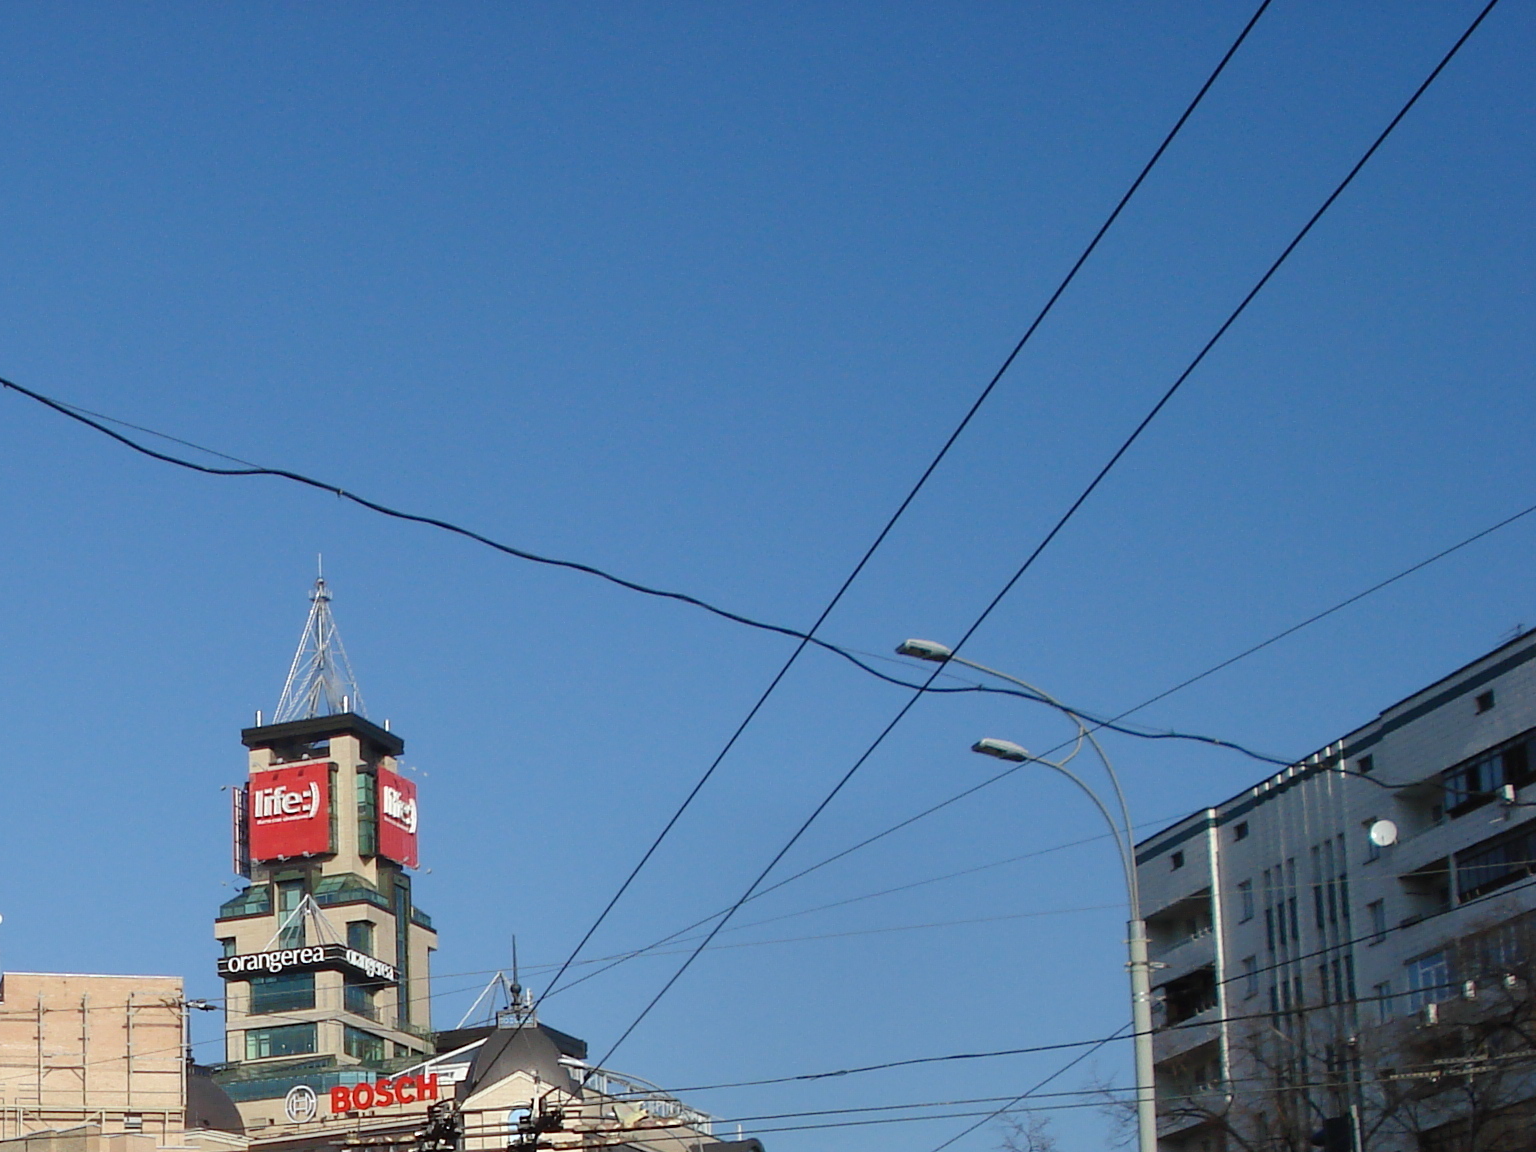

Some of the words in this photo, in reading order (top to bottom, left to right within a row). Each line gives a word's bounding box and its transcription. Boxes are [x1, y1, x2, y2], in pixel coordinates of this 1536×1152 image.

[227, 946, 325, 973] orangerea
[345, 948, 395, 982] orangerea
[330, 1073, 438, 1114] BOSCH
